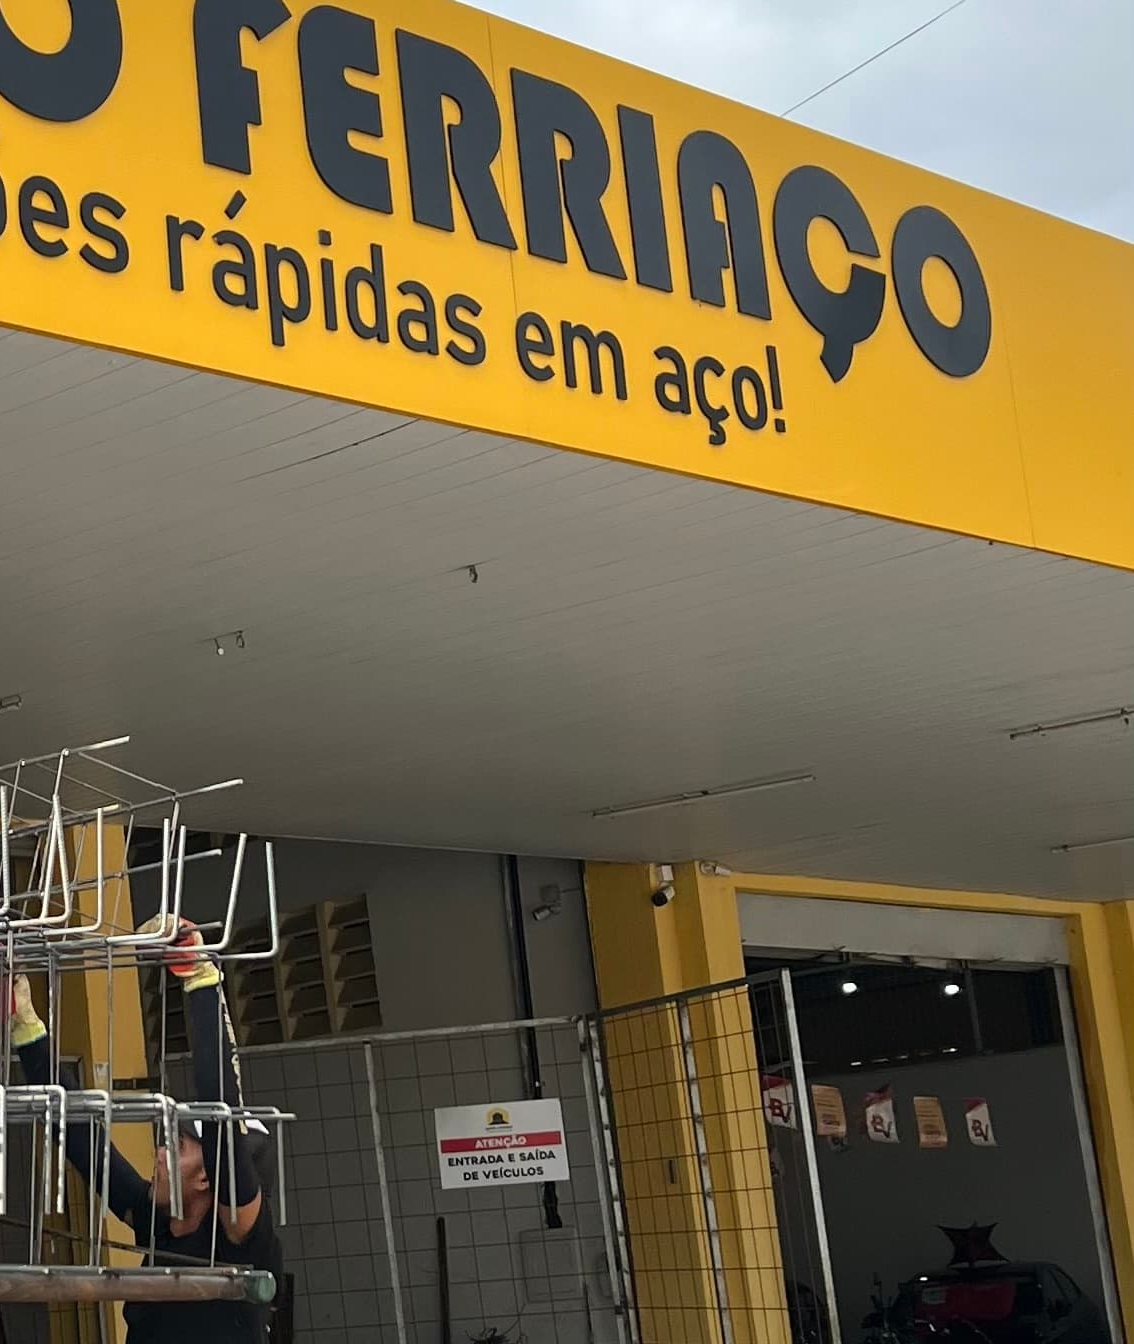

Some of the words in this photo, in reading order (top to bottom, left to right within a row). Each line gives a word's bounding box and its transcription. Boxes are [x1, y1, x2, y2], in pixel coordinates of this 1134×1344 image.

[166, 191, 487, 366] rápidas
[515, 311, 627, 401] em
[654, 346, 786, 446] aço!
[475, 1134, 527, 1149] ATENÇÃO
[448, 1154, 505, 1167] ENTRADA
[508, 1153, 516, 1163] E
[519, 1149, 556, 1162] SAÍDA
[463, 1171, 479, 1181] DE
[482, 1166, 544, 1179] VEÍCULOS
